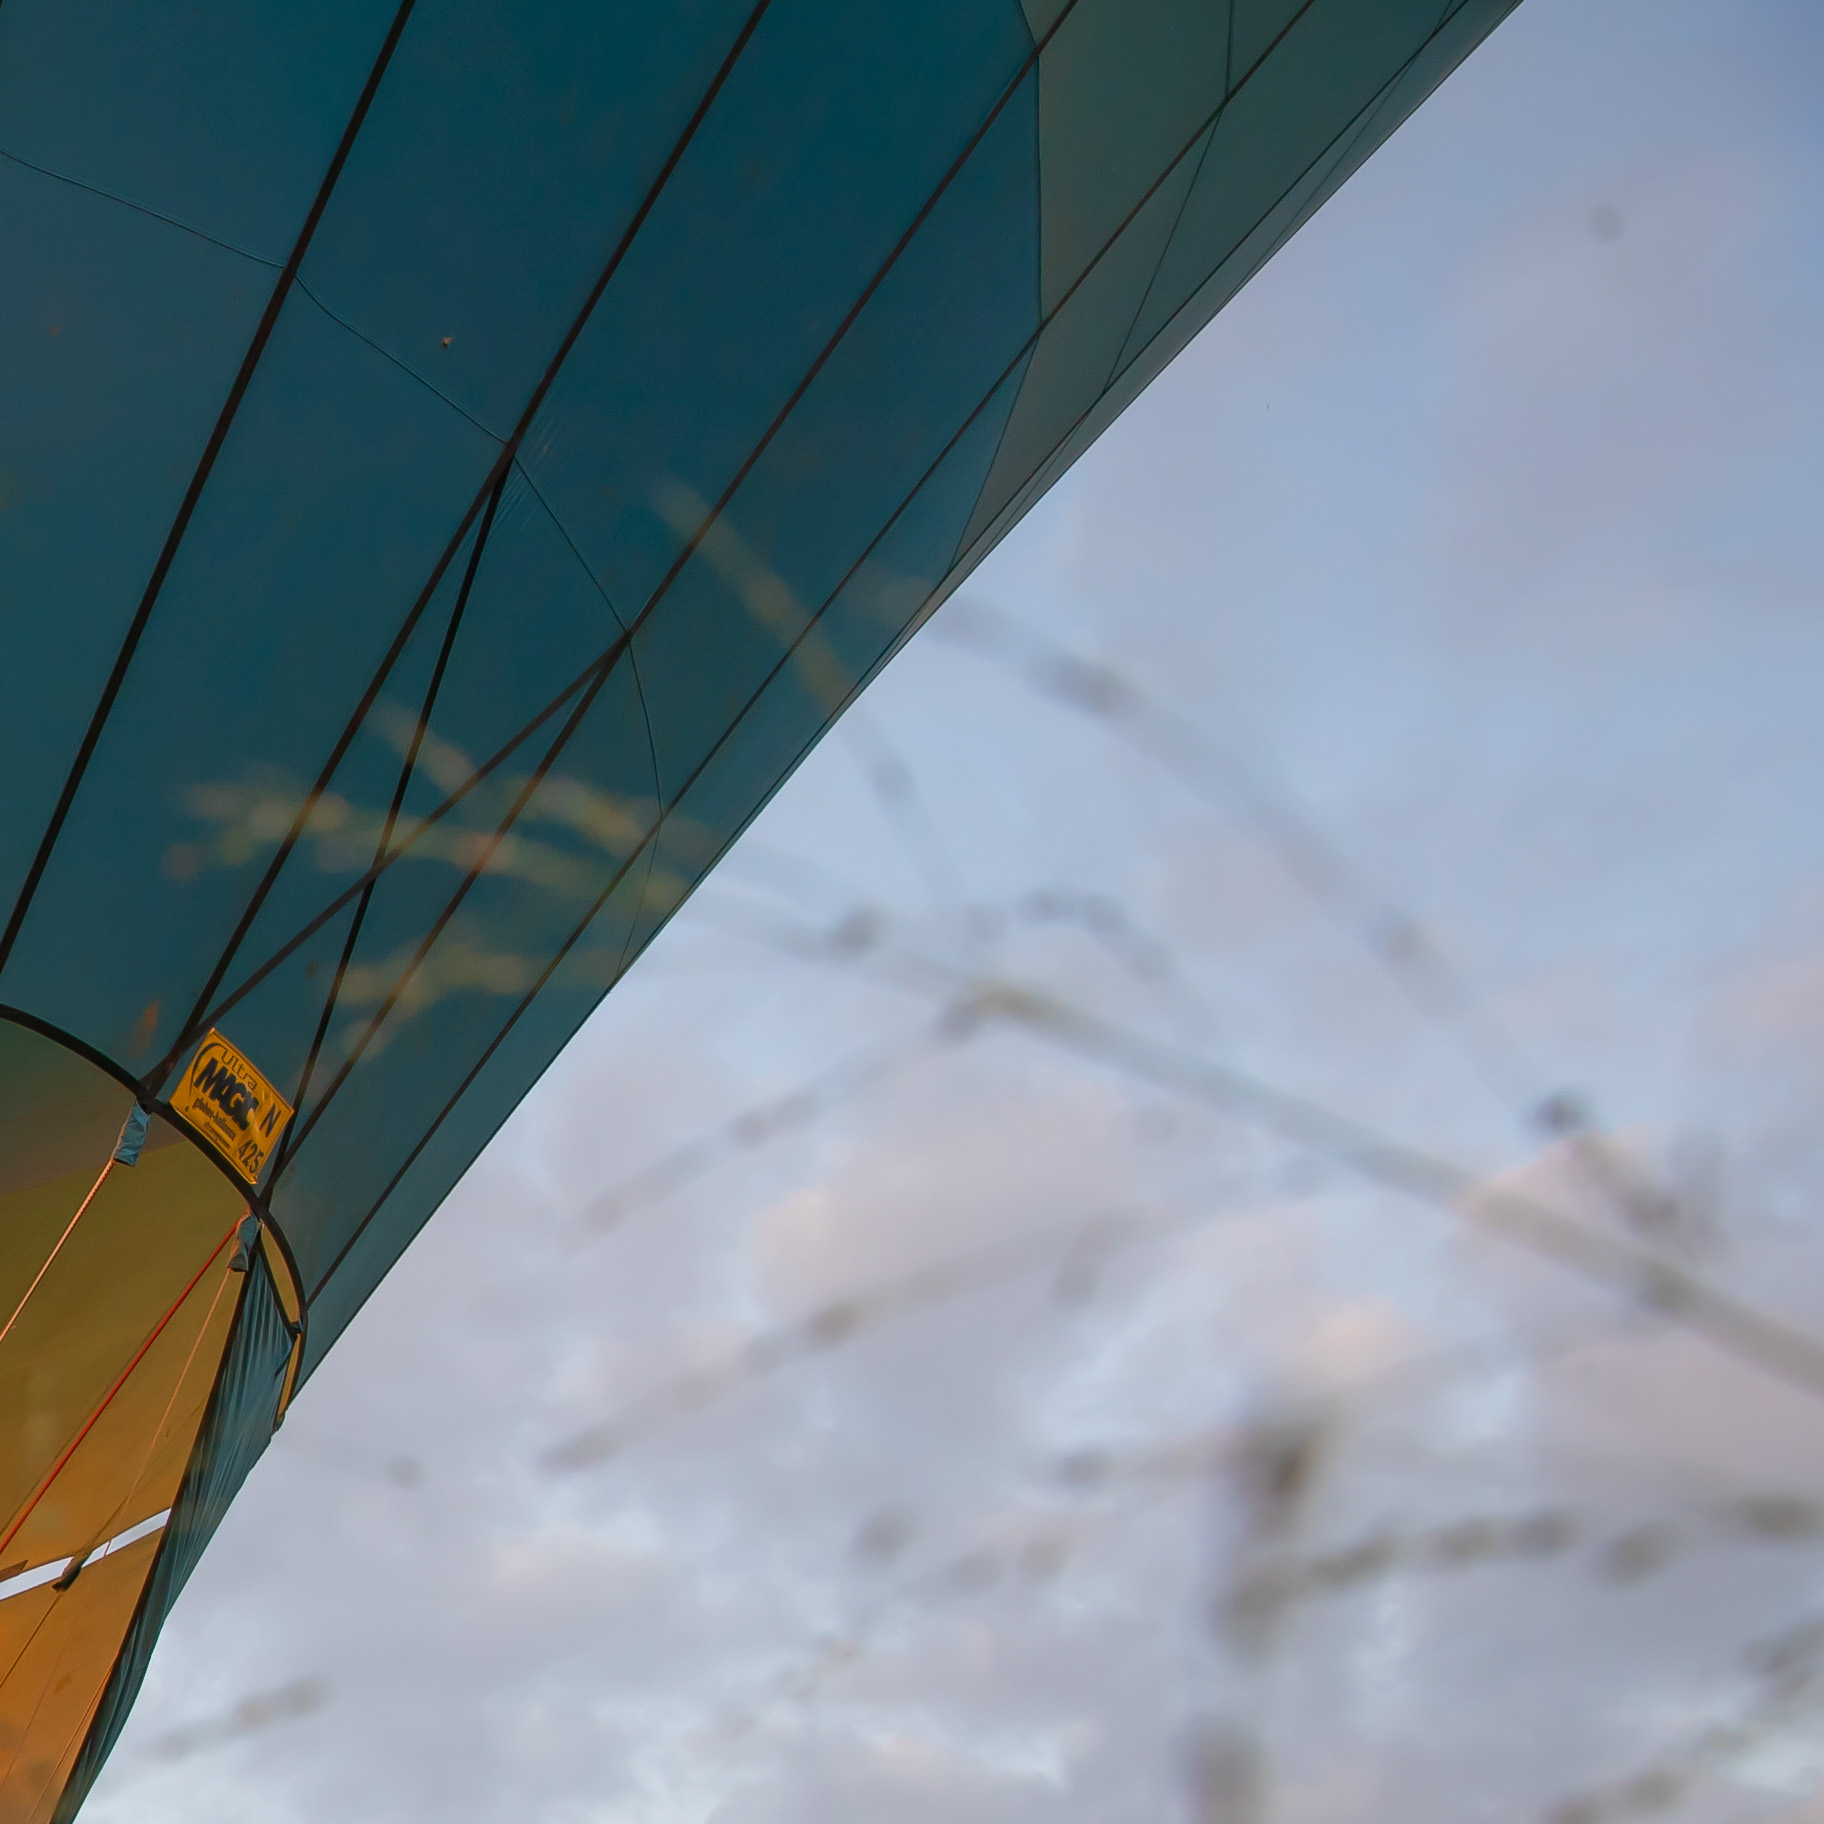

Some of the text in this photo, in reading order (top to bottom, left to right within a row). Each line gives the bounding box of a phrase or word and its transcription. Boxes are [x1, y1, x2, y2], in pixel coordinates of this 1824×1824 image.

[221, 1047, 258, 1091] Ultra
[259, 1103, 282, 1138] N
[238, 1139, 265, 1174] 425
